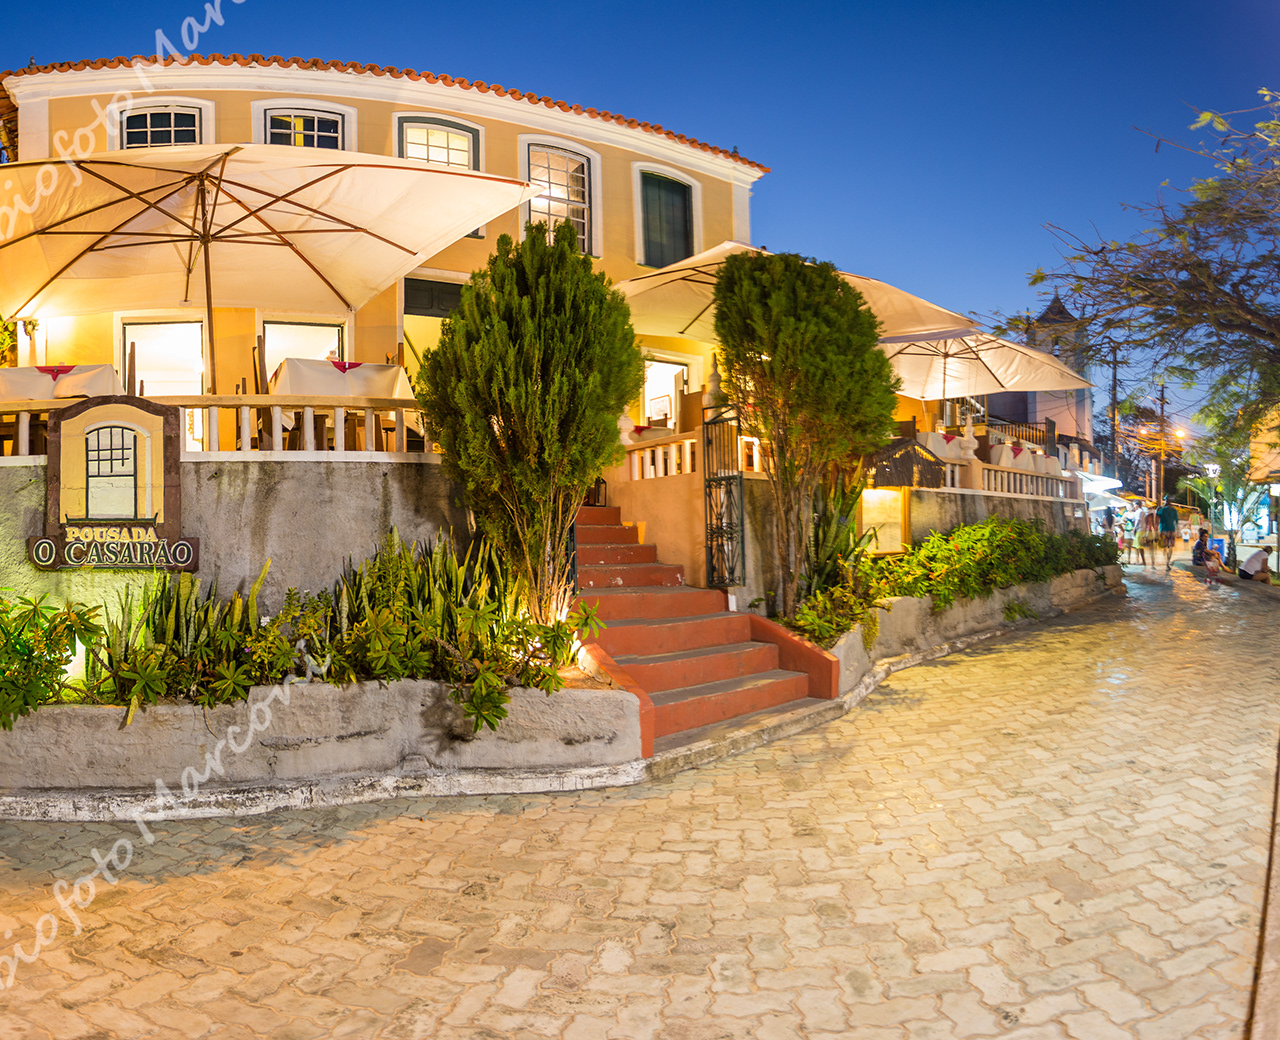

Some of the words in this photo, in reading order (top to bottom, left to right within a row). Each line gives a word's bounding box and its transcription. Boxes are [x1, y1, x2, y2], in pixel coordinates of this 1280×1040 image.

[65, 526, 159, 543] POUSADA
[33, 539, 56, 566] O
[64, 538, 194, 566] CASARÃO
